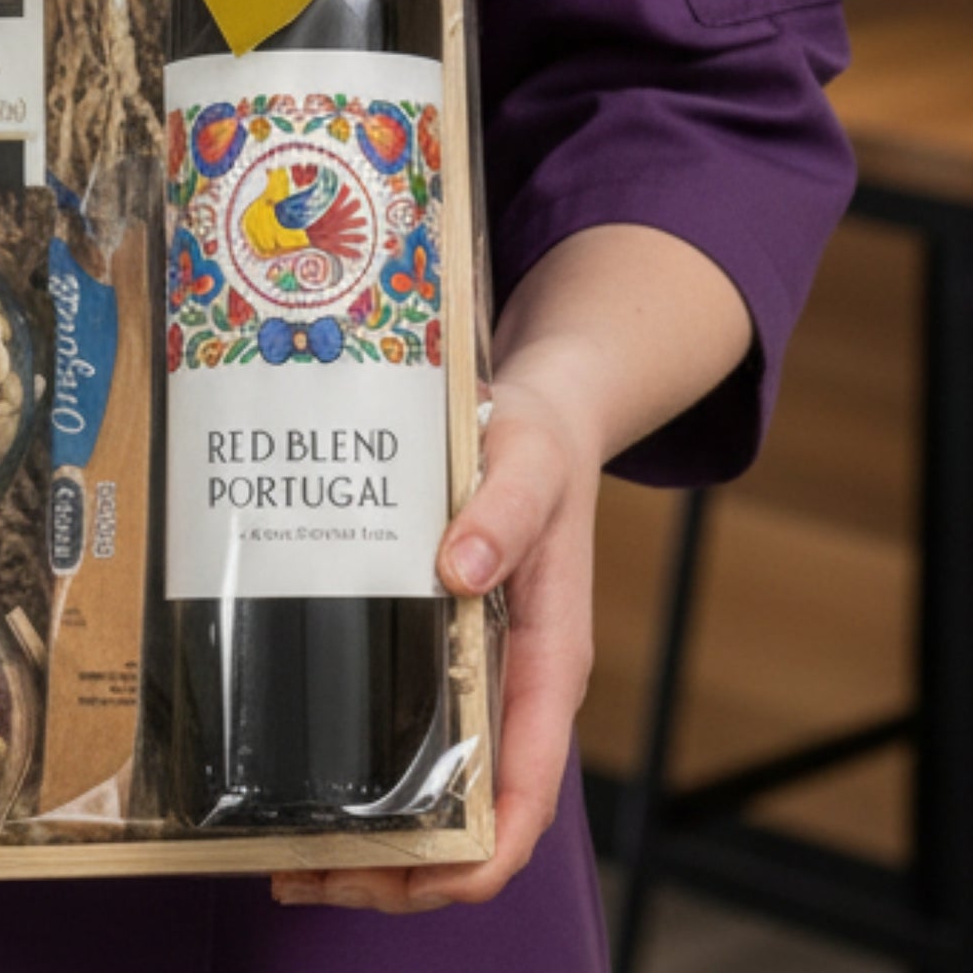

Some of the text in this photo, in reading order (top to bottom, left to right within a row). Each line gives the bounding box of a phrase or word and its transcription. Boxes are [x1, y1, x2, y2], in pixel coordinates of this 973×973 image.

[208, 429, 398, 464] RED BLEND
[208, 476, 398, 509] PORTUGAL
